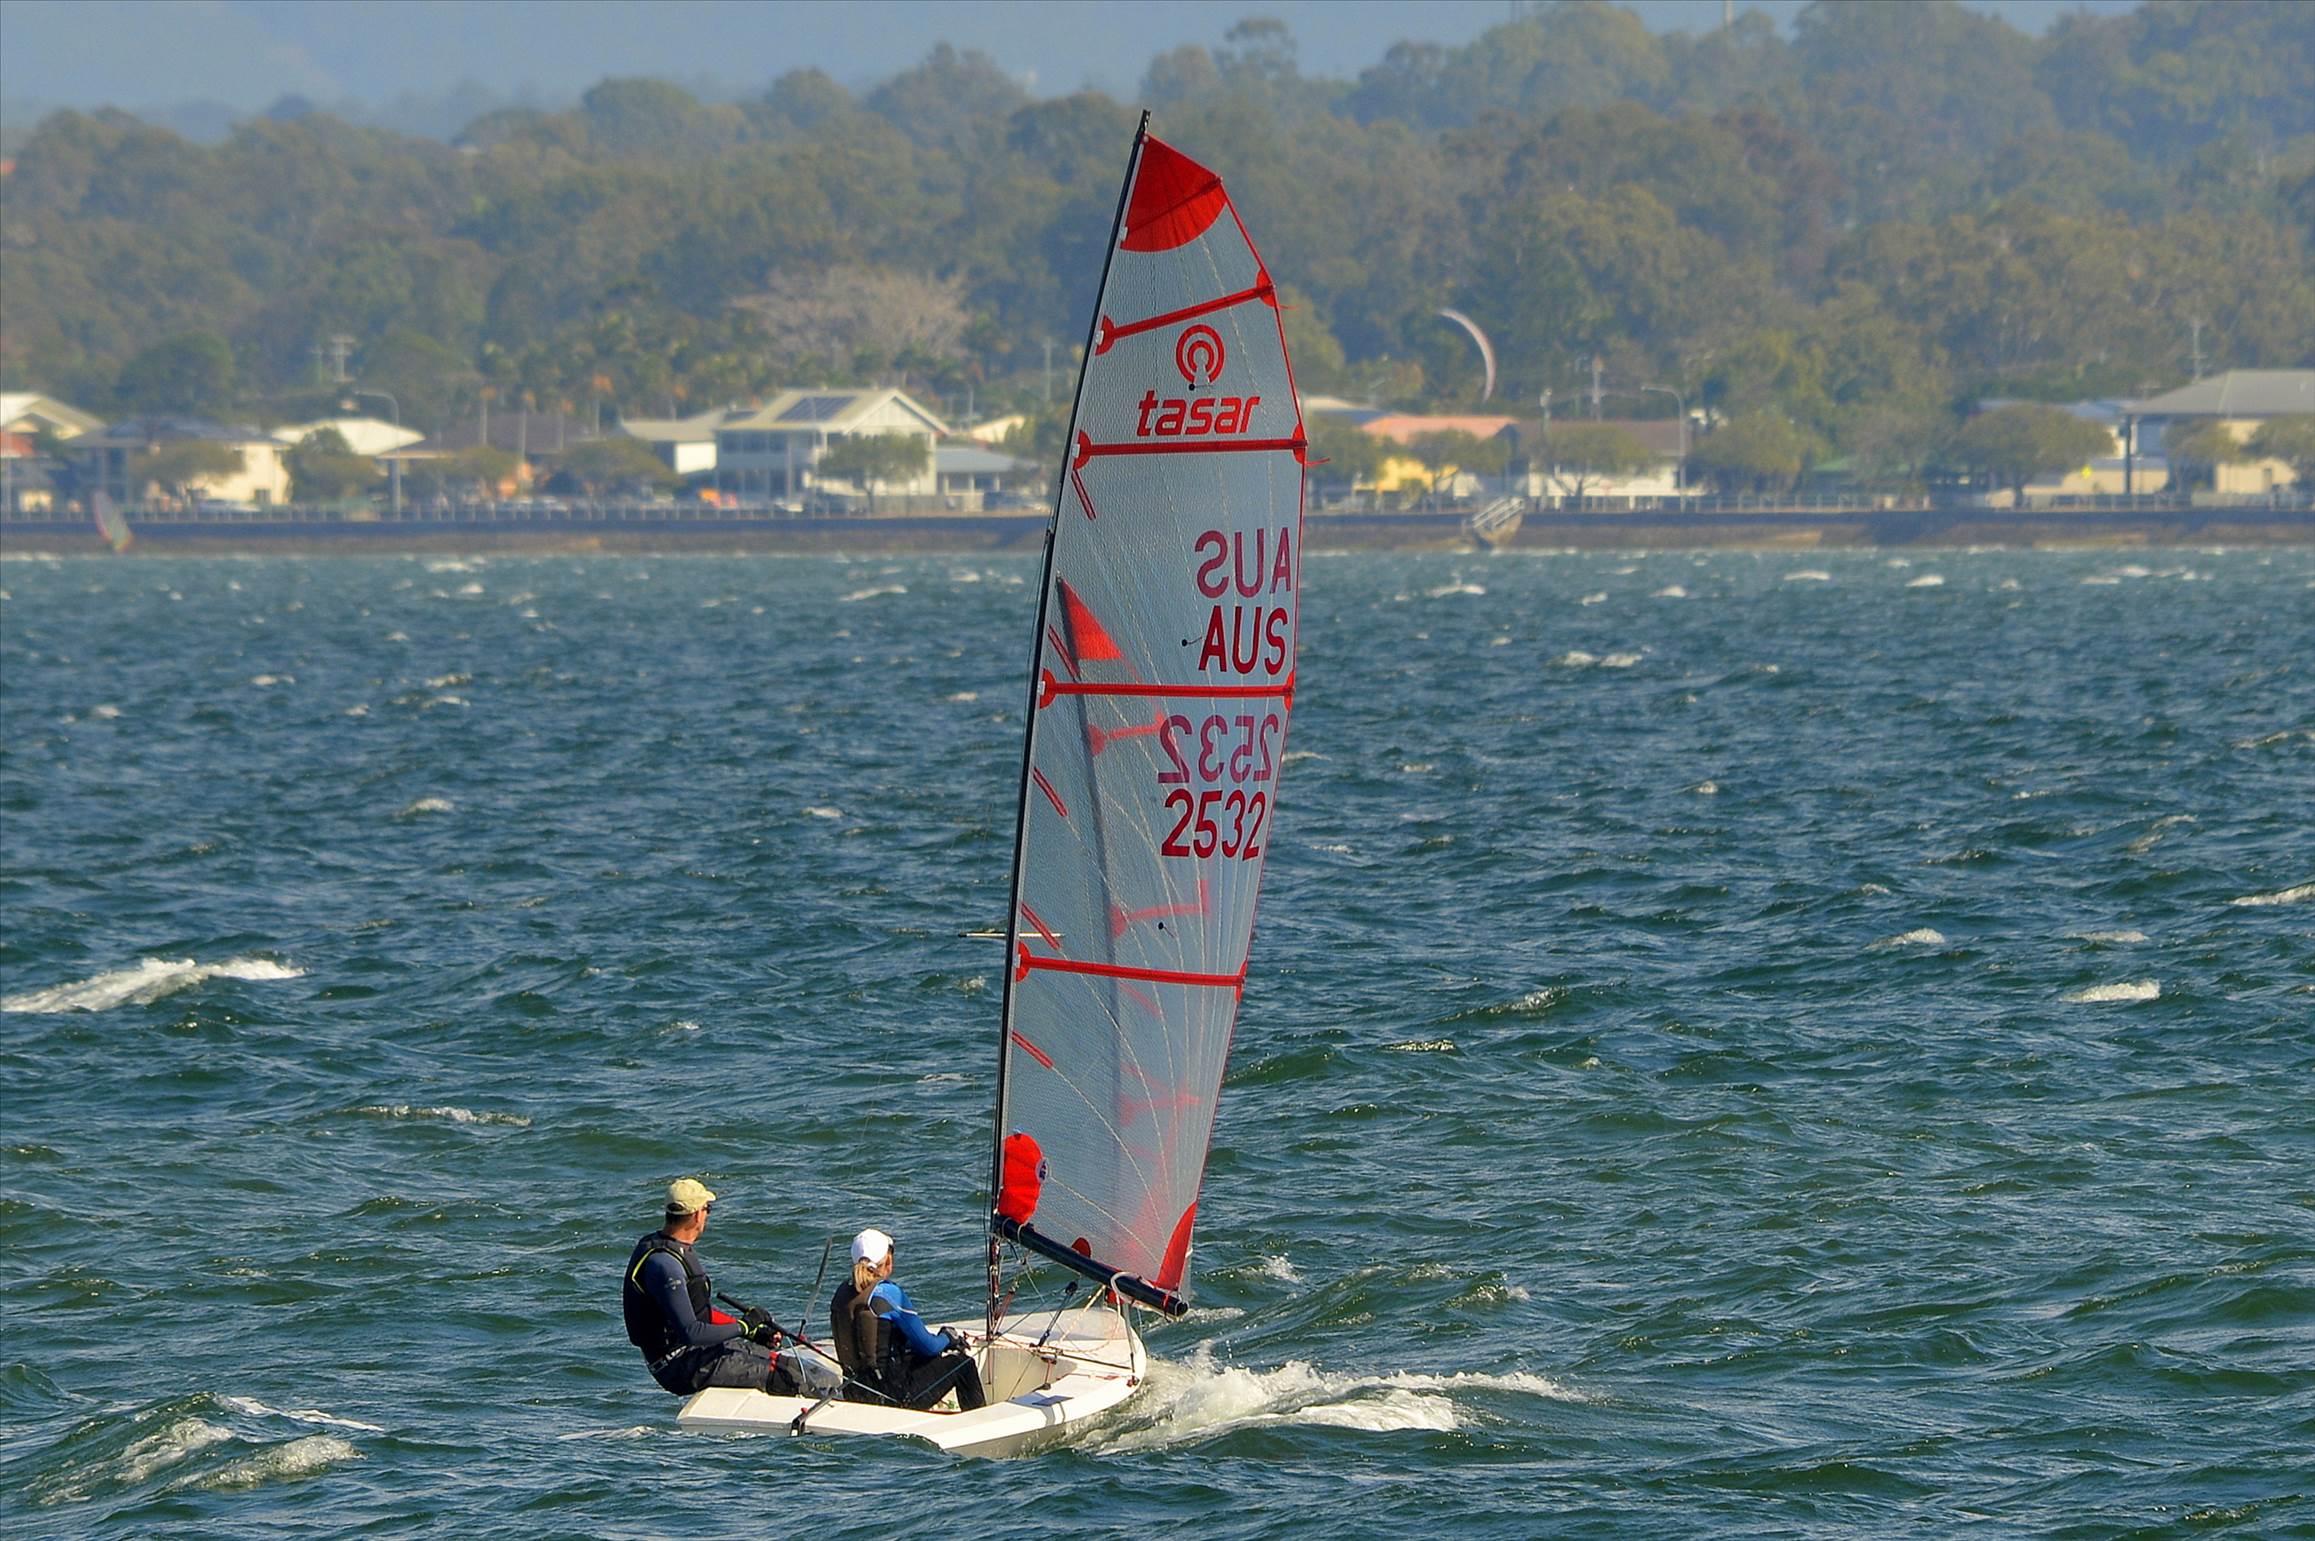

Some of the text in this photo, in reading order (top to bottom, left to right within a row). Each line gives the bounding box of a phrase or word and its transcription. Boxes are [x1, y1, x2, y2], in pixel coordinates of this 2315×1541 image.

[1137, 390, 1260, 436] tasar
[1198, 605, 1288, 675] AUS
[1161, 788, 1266, 861] 2532
